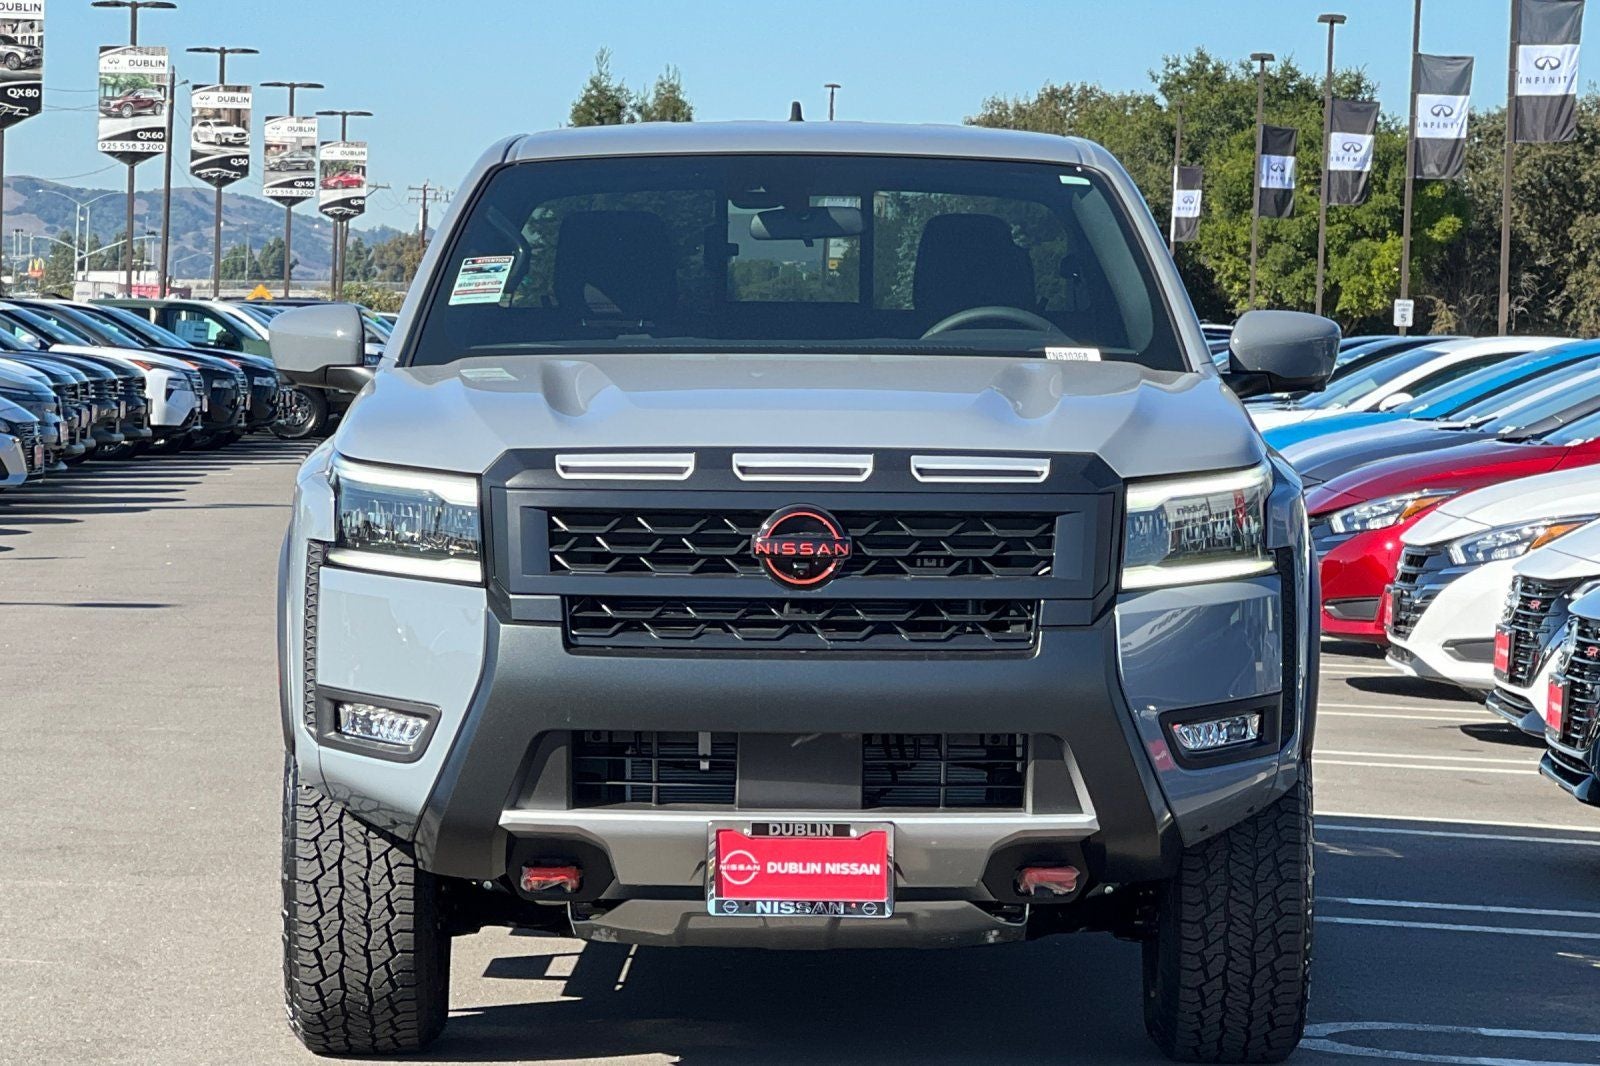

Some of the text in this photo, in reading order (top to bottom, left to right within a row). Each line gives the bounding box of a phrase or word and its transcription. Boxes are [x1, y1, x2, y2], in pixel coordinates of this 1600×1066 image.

[0, 2, 42, 12] DUBLIN
[128, 59, 166, 68] DUBLIN
[6, 87, 40, 99] QX80
[217, 95, 250, 104] DUBLIN
[287, 125, 316, 133] DUBLIN
[136, 130, 164, 140] QX60
[100, 142, 117, 151] 925
[140, 142, 165, 151] 3200
[230, 157, 249, 167] Q50
[1401, 313, 1407, 322] 5
[754, 542, 849, 556] NISSAN
[768, 823, 835, 837] DUBLIN
[719, 863, 761, 872] NISSAN
[766, 861, 881, 875] DUBLIN NISSAN
[755, 901, 845, 915] NISSAN
